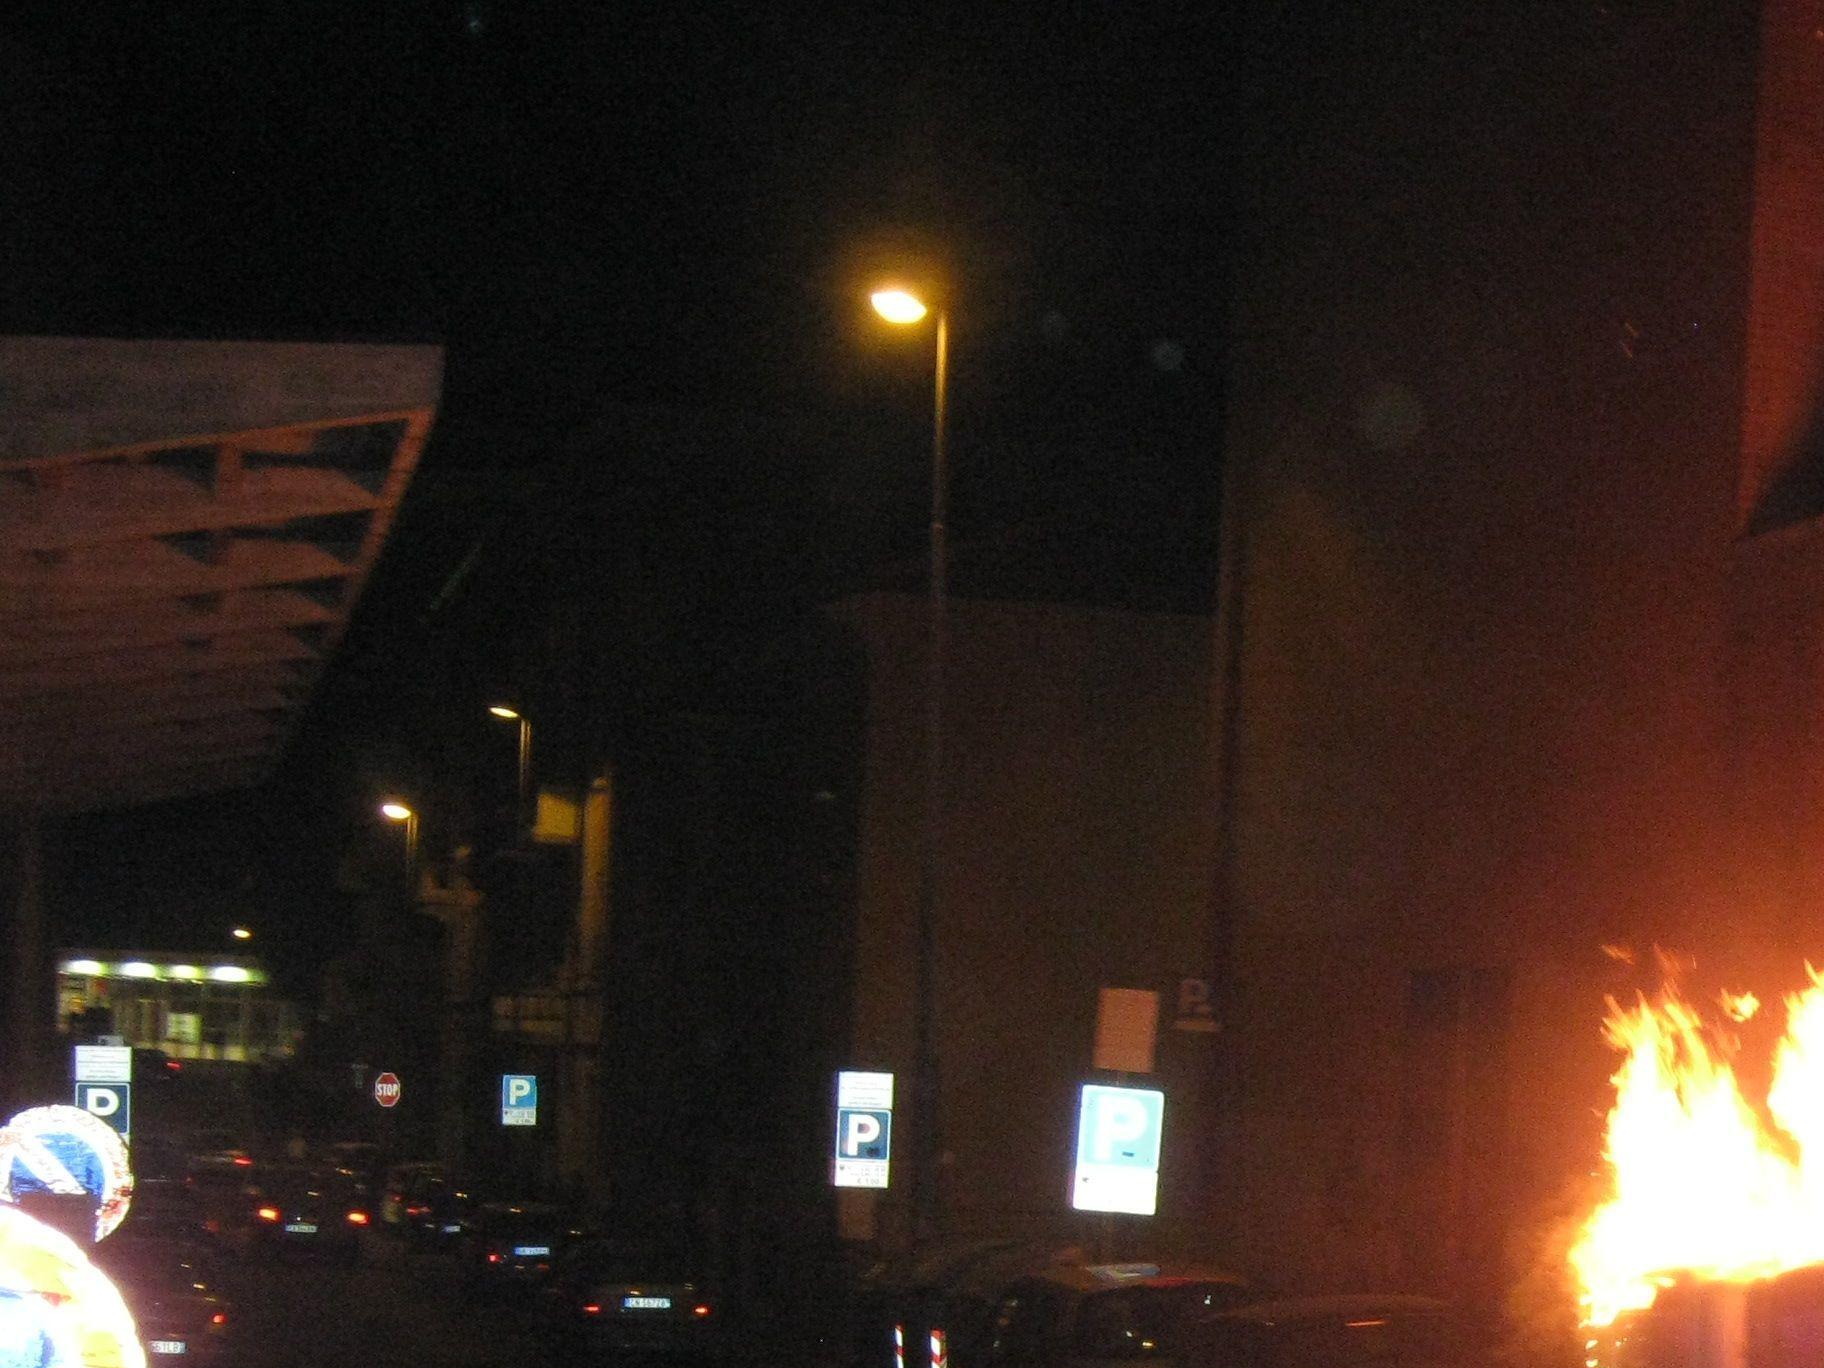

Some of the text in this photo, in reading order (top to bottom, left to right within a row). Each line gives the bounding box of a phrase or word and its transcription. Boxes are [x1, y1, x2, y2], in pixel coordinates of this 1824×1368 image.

[378, 1084, 399, 1096] STOP
[510, 1079, 530, 1105] P
[848, 1113, 880, 1156] P
[1095, 1095, 1147, 1161] P
